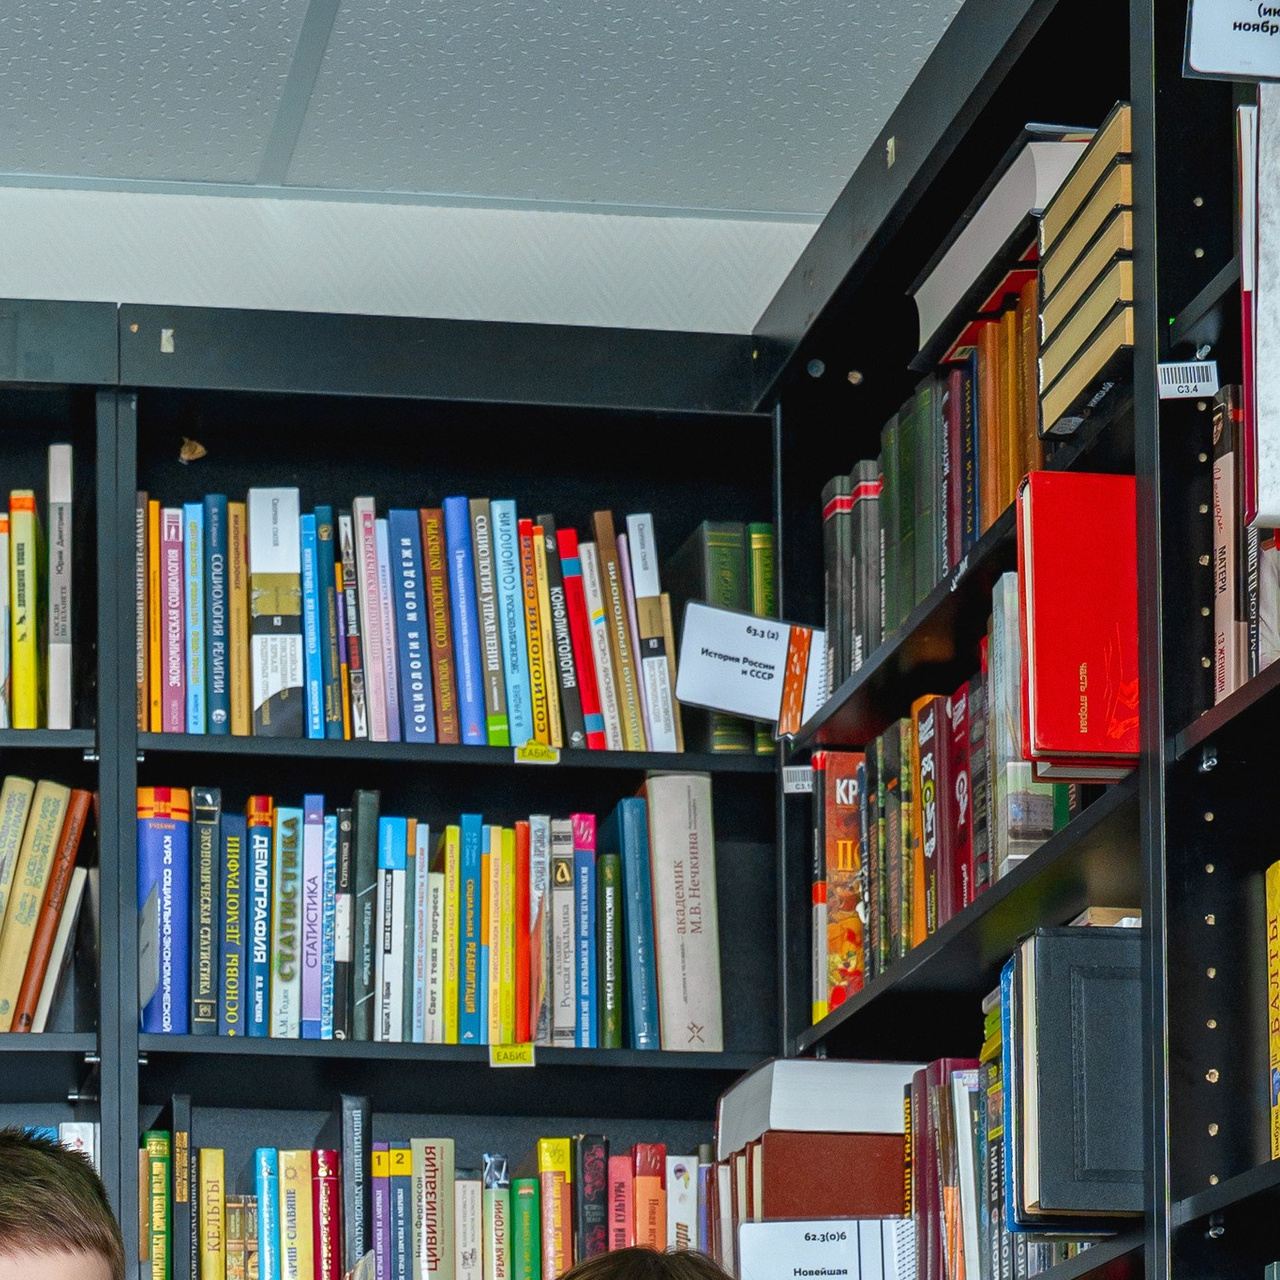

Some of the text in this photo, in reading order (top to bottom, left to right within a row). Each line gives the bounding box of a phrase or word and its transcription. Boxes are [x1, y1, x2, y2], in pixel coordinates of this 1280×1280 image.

[426, 518, 447, 649] СОЦИОЛОГИЯ КУЛЬТУРЫ
[475, 515, 501, 672] СОЦИОЛОГИЯ УПРАВЛЕНИЯ
[1218, 545, 1227, 595] МАТЕРИ
[168, 549, 181, 688] ЭКОНОМИЧЕСКАЯ СОЦИОЛОГИЯ
[211, 553, 224, 695] СОЦИОЛОГИЯ РЕЛИГИИ
[400, 537, 428, 734] СОЦИОЛОГИЯ МОЛОДЕЖИ
[521, 535, 547, 733] СОЦИОЛОГИЯ СЕМЬИ
[550, 586, 576, 690] КОНФЛИКТОЛОГИЯ
[701, 647, 776, 671] История России
[750, 669, 775, 681] СССР
[1079, 662, 1088, 734] часть вторая
[1218, 648, 1226, 693] ЖЕНЩИН
[199, 828, 212, 995] ЭКОНОМИЧЕСКАЯ СТАТИСТИКА
[252, 834, 269, 964] ДЕМОГРАФИЯ
[275, 817, 299, 982] СТАТИСТИКА
[305, 876, 319, 969] СТАТИСТИКА
[673, 860, 685, 936] академик
[687, 832, 703, 934] М.В. Нечкина
[224, 835, 241, 1024] ОСНОВЫ ДЕМОГРАФИИ
[1269, 914, 1280, 1038] БАЛТЫ
[496, 1051, 528, 1062] ЕАБИС
[374, 1155, 382, 1166] 1
[395, 1153, 405, 1165] 2
[991, 1146, 999, 1201] БУНИЧ
[207, 1178, 220, 1253] КЕЛЬТЫ
[423, 1145, 438, 1273] Цивилизация
[494, 1200, 504, 1237] ИСТОРИИ
[804, 1232, 847, 1242] 62.3(0)6
[496, 1239, 504, 1278] ВРЕМЯ
[793, 1268, 848, 1276] Новейшая
